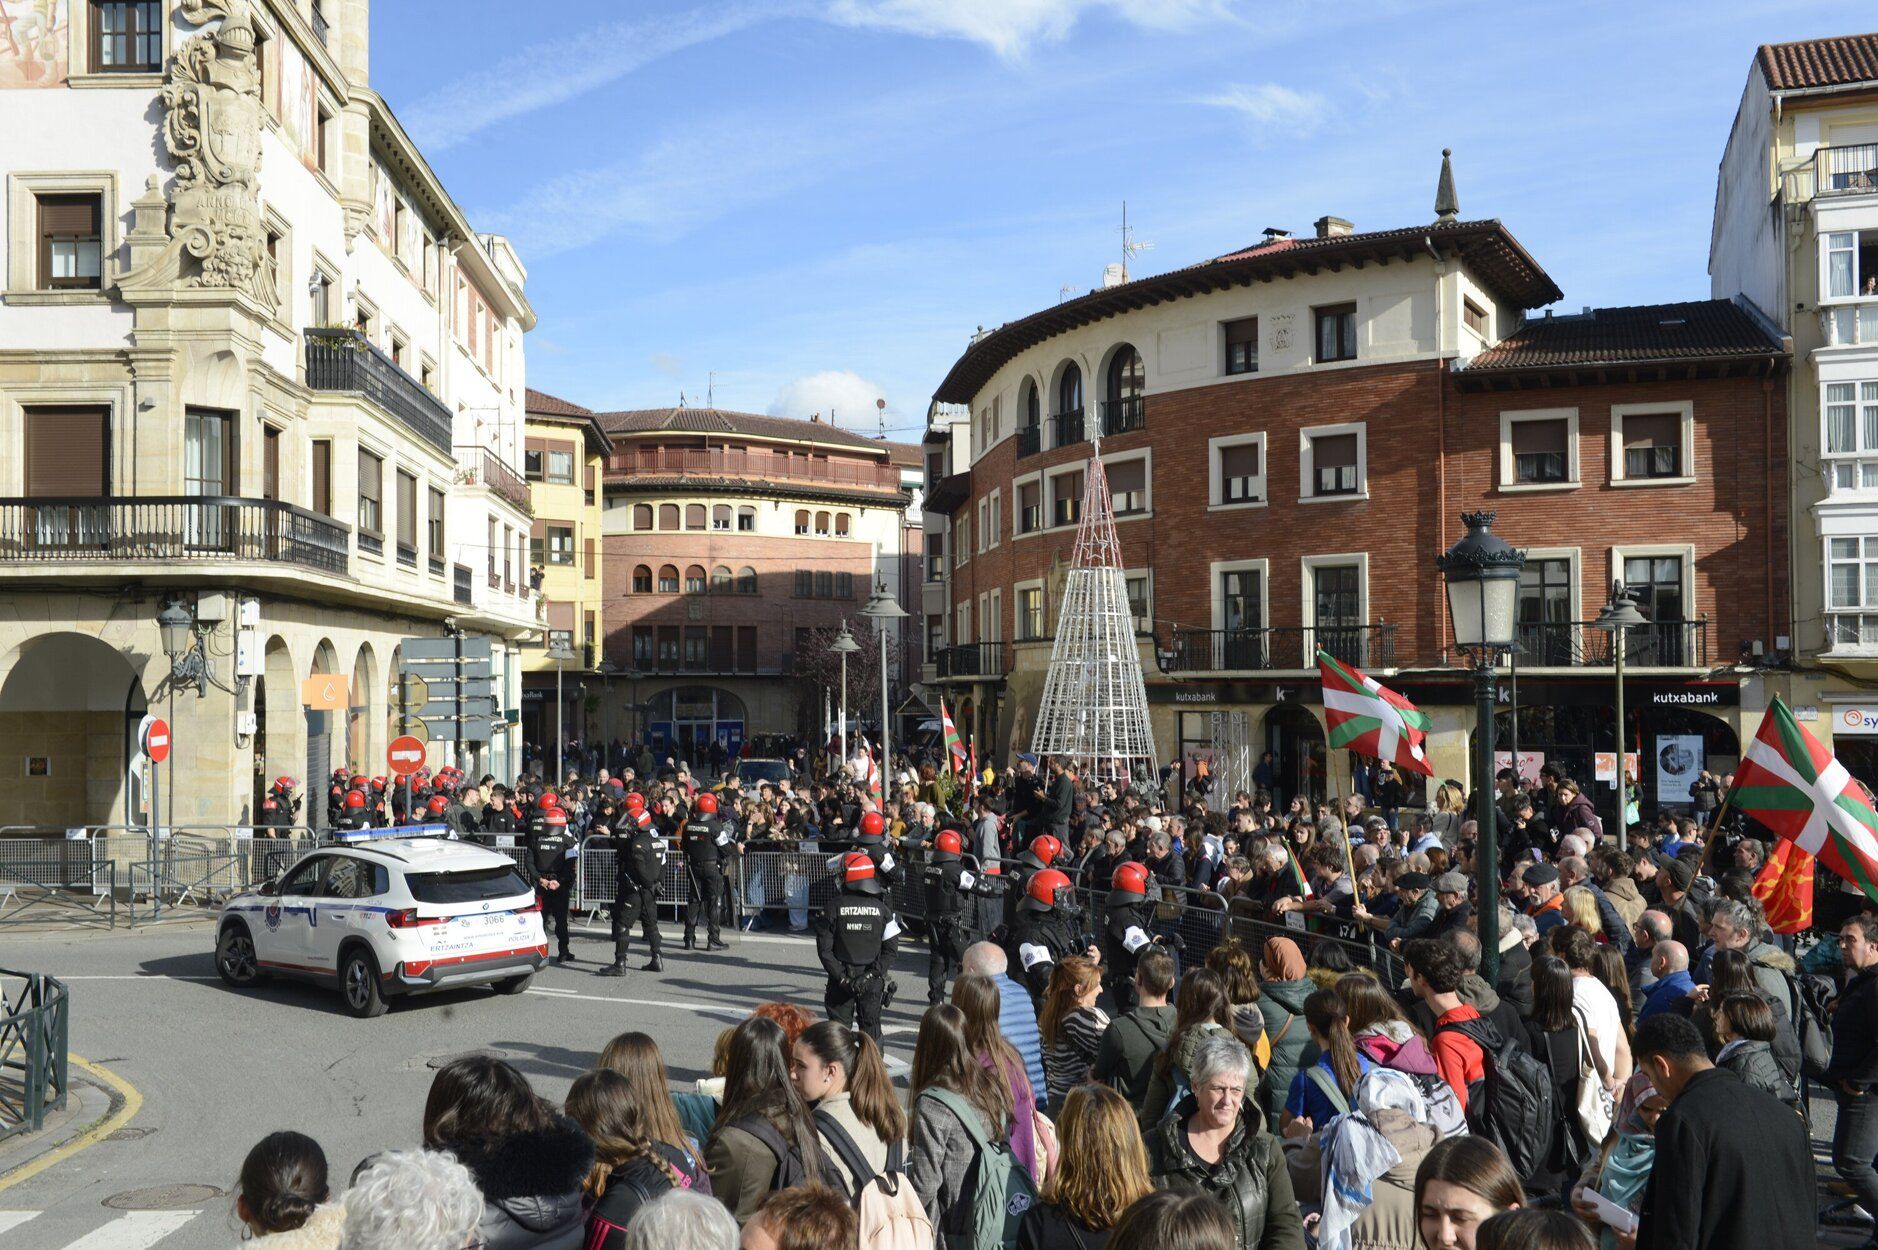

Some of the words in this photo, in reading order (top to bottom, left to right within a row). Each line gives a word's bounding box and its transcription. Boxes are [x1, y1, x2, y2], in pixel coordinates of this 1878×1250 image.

[1175, 692, 1216, 702] kutxabank
[1499, 686, 1510, 703] k
[1653, 692, 1718, 704] kutxabank
[840, 906, 880, 916] ERTZAINTZA
[484, 915, 505, 926] 3066
[430, 942, 474, 952] ERTZAINTZA
